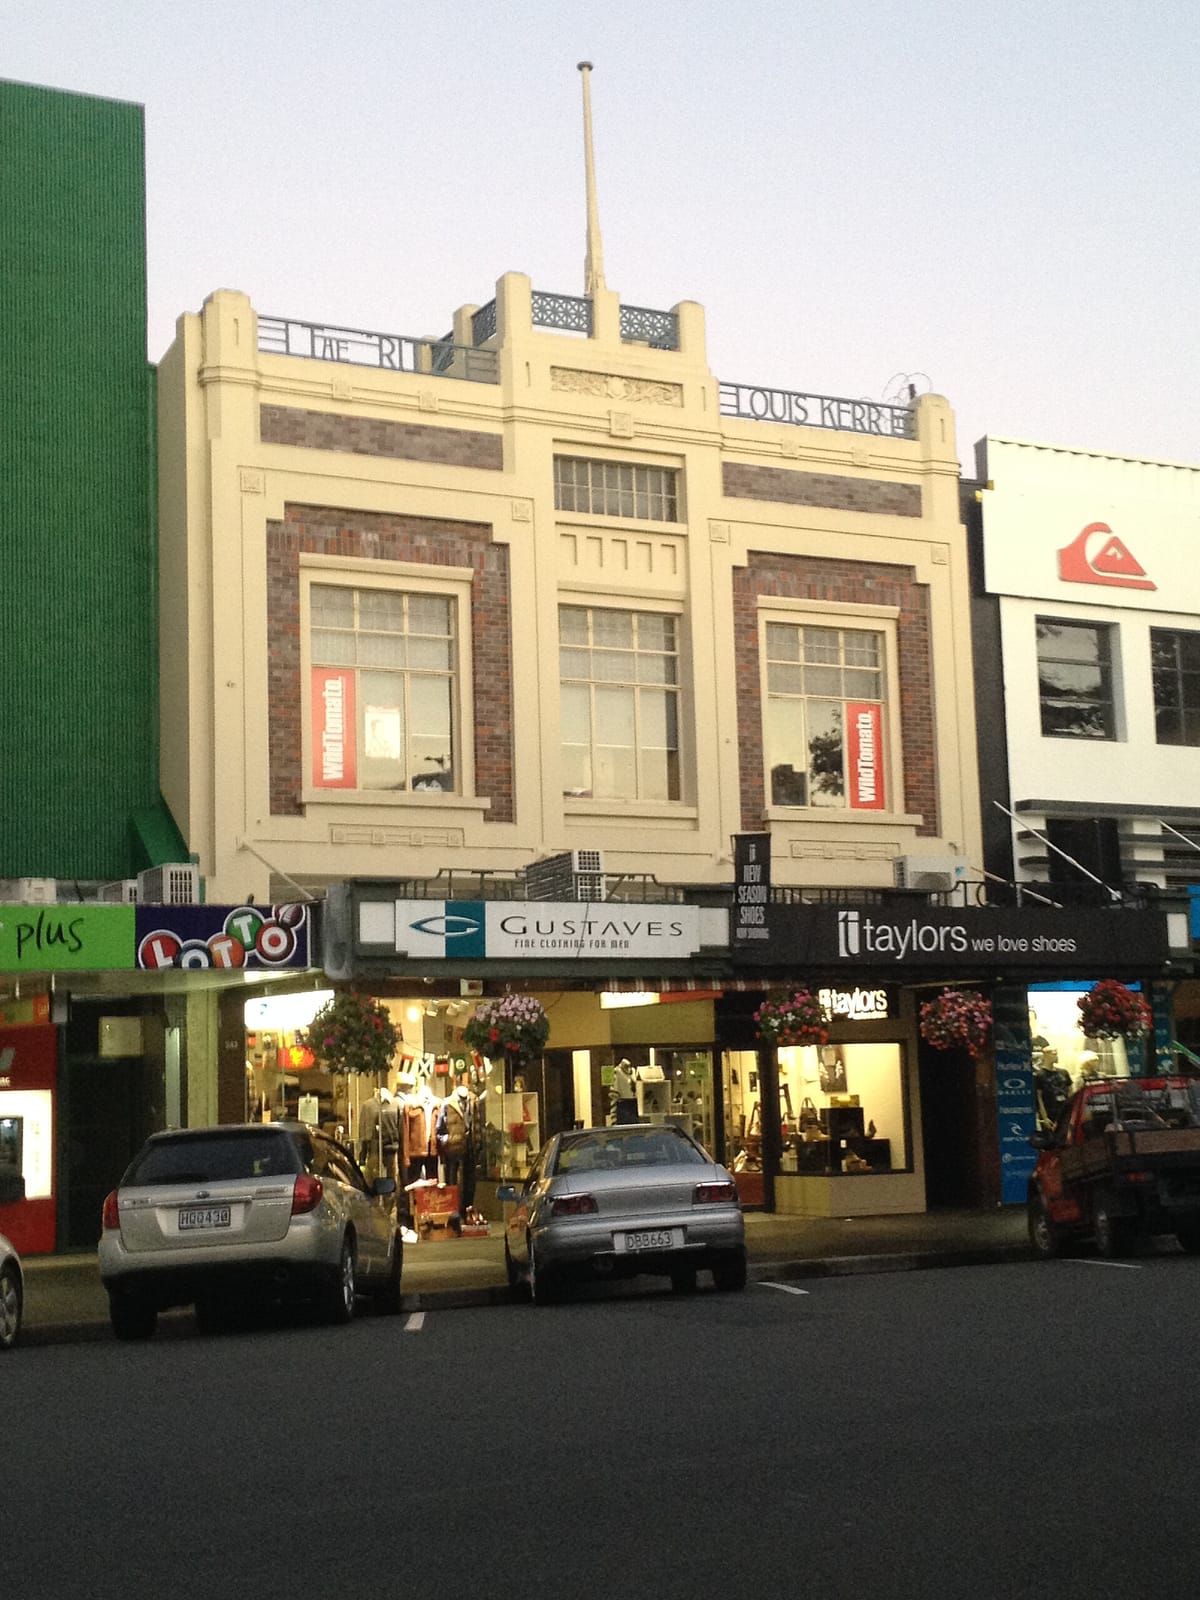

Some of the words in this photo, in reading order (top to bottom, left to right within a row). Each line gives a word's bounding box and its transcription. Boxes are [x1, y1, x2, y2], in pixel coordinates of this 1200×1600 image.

[736, 385, 809, 425] LOUIS
[820, 396, 883, 435] KERR
[743, 864, 761, 882] NEW
[738, 885, 767, 903] SEASON
[500, 915, 683, 937] GUSTAVES
[740, 906, 765, 924] SHOES
[16, 909, 85, 959] plus
[152, 914, 288, 968] LOTTO
[514, 938, 536, 949] FINE
[539, 938, 585, 949] CLOTHING
[589, 939, 606, 949] FOR
[610, 939, 630, 949] MEN
[863, 918, 967, 960] taylors
[971, 938, 994, 952] we
[998, 934, 1028, 952] love
[1031, 935, 1077, 952] shoes
[831, 986, 888, 1018] taylors
